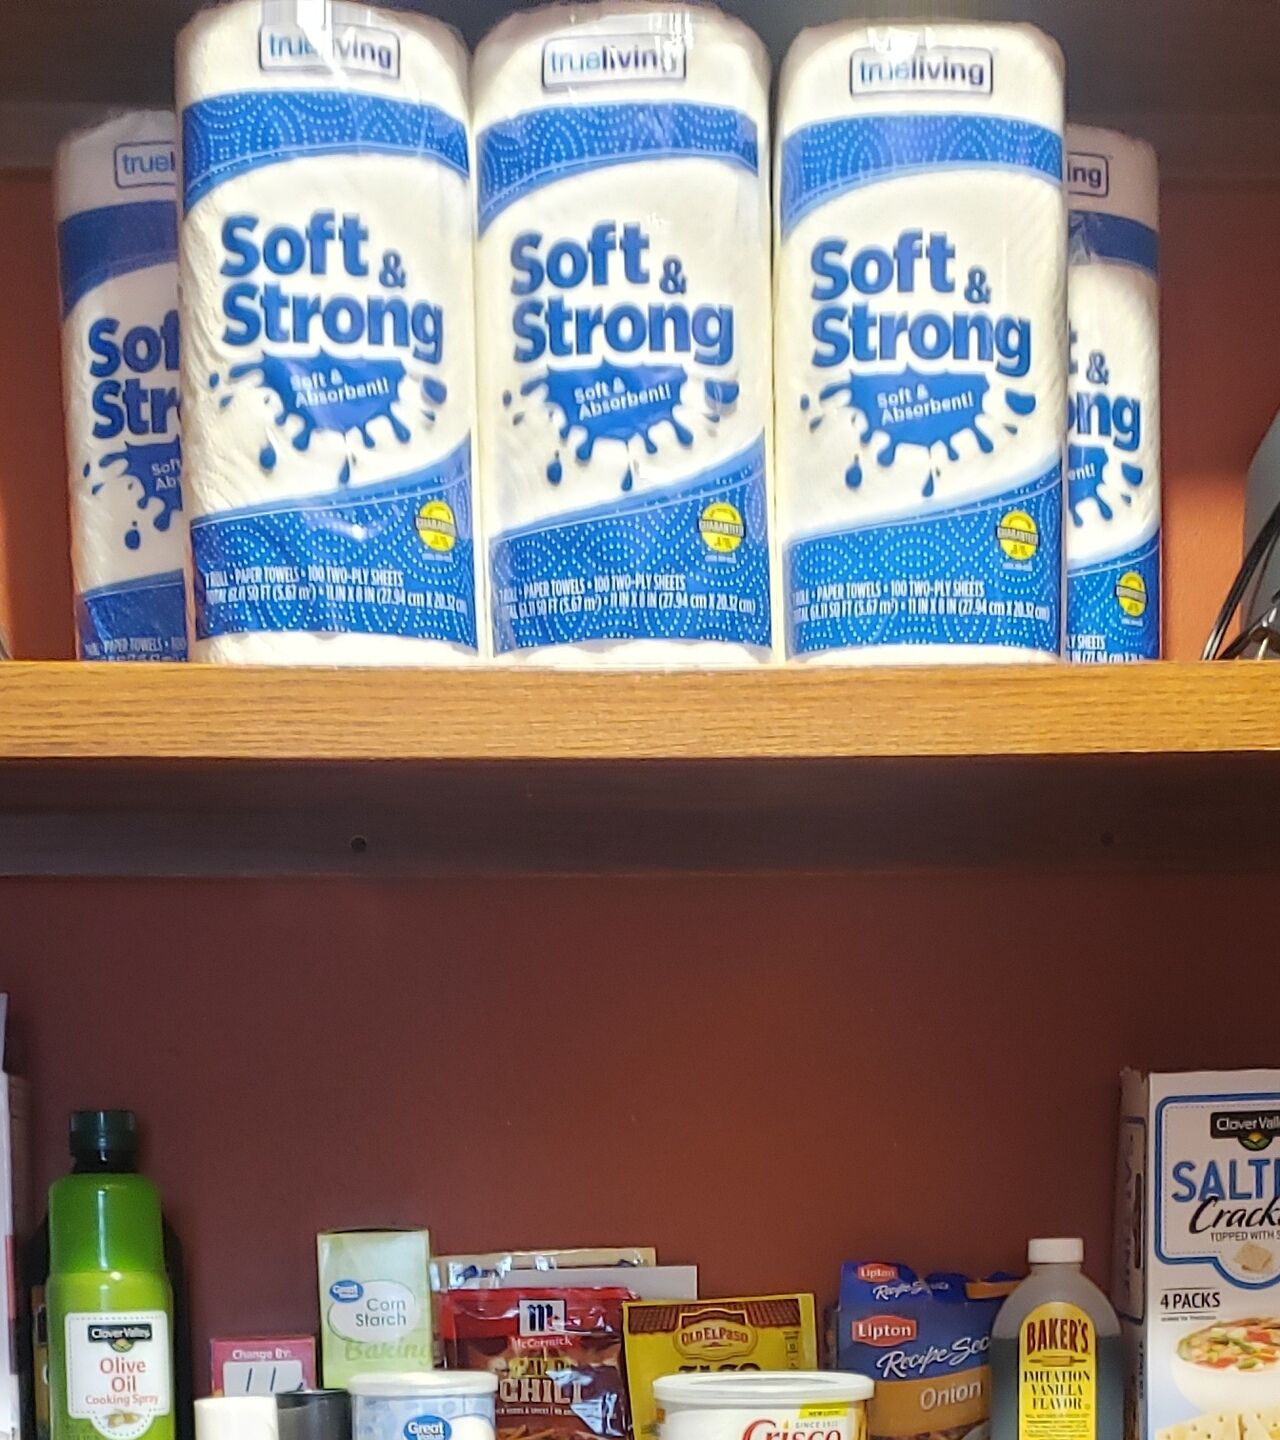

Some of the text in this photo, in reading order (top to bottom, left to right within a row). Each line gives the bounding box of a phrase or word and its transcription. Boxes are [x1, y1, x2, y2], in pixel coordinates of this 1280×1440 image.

[860, 57, 984, 86] trueliving
[122, 149, 176, 175] truel
[221, 208, 407, 289] Soft &
[510, 219, 687, 296] Soft &
[811, 228, 991, 305] Soft &
[222, 282, 443, 364] Strong
[512, 295, 734, 366] Strong
[89, 309, 180, 378] Sof
[812, 302, 1032, 377] Strong
[1086, 351, 1109, 386] &
[291, 374, 325, 392] Soft
[574, 382, 609, 403] Soft
[295, 379, 390, 409] Absorbent!
[579, 383, 671, 421] Absorbent!
[877, 390, 911, 409] Soft
[92, 379, 181, 438] Str
[881, 390, 975, 427] Absorbent!
[235, 565, 403, 587] PAPER TOWELS 100 TWO-PLY SHEETS
[523, 574, 686, 600] PAPER TOWELS 100 TWO-PLY SHEETS
[817, 580, 985, 600] PAPER TOWELS 100 TWO-PLY SHEETS
[1216, 1117, 1257, 1132] Clover
[1210, 1231, 1248, 1242] TOPPED
[1250, 1230, 1274, 1241] WITH
[860, 1266, 895, 1279] Lipton
[366, 1298, 406, 1312] Corn
[1160, 1291, 1221, 1310] 4 PACKS
[355, 1312, 407, 1328] Starch
[681, 1331, 703, 1346] OLD
[857, 1323, 912, 1341] Lipton
[1026, 1318, 1090, 1355] BAKER'S
[100, 1357, 146, 1374] Olive
[876, 1346, 952, 1379] Recipe
[111, 1375, 137, 1393] Oil
[1024, 1370, 1091, 1383] IMITATION
[85, 1393, 158, 1407] Cooking Spray
[920, 1380, 982, 1412] Onion
[1031, 1384, 1083, 1396] VANILLA
[1033, 1397, 1083, 1410] FLAVOR
[407, 1421, 444, 1435] Great
